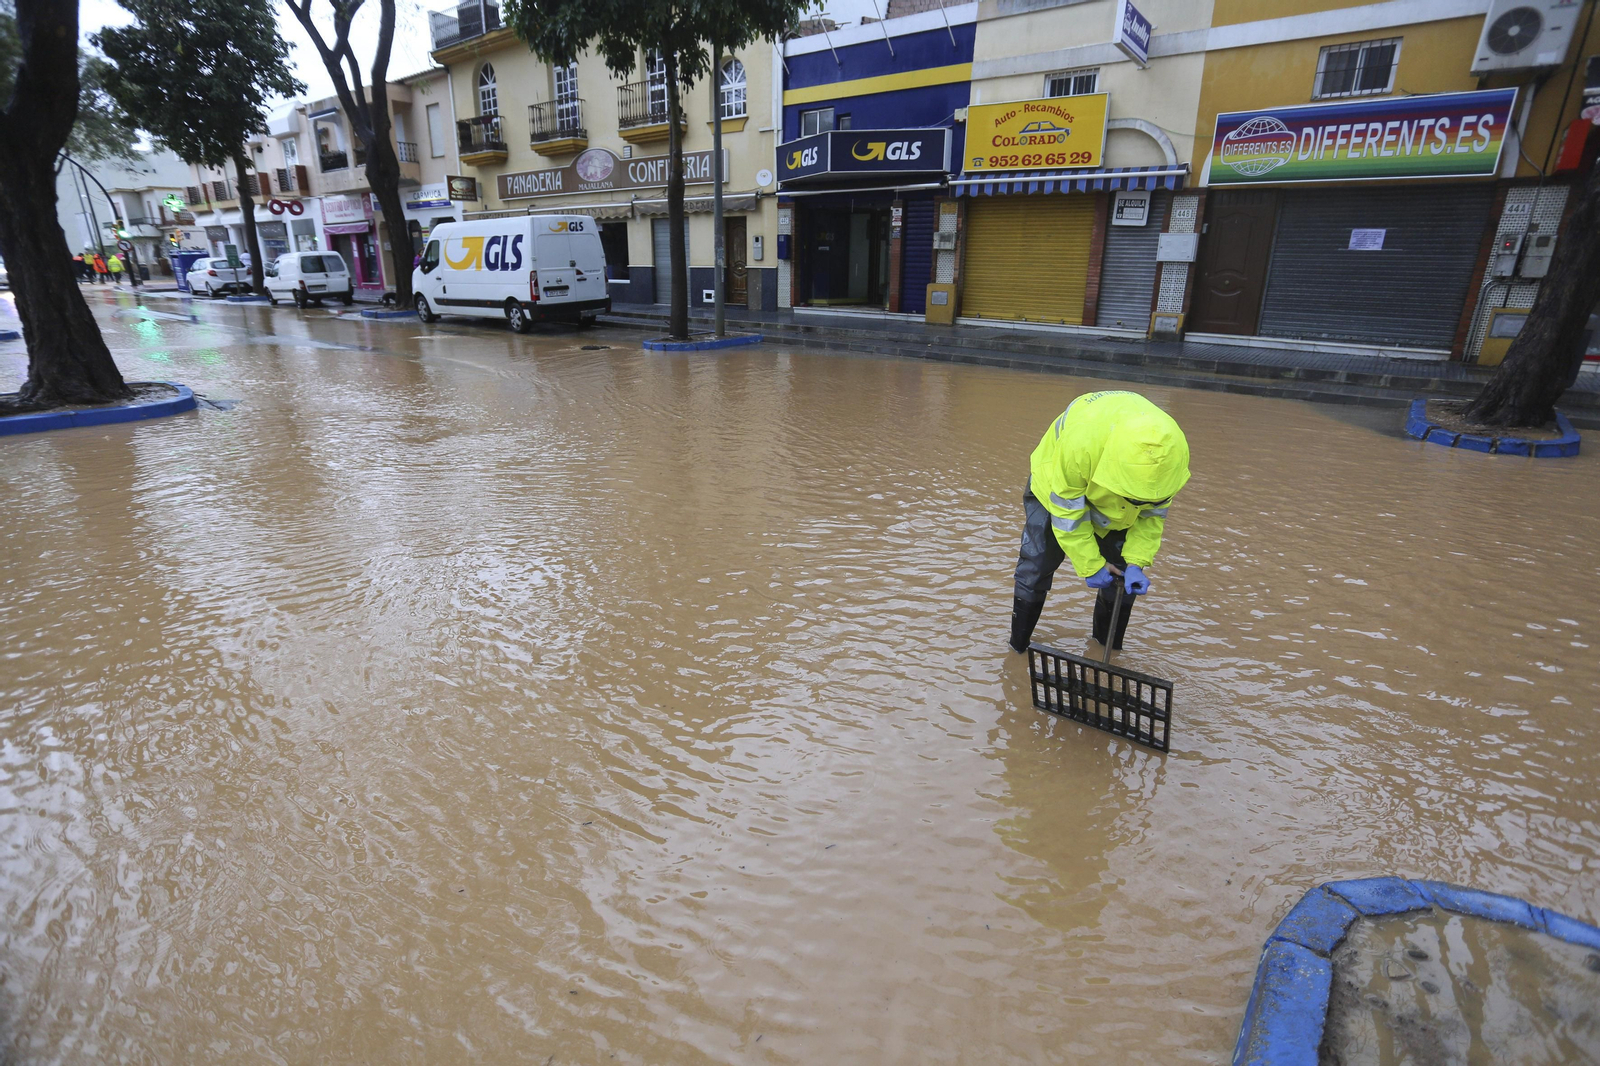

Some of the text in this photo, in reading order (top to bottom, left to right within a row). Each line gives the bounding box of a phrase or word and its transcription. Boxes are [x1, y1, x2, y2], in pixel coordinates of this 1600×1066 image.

[994, 110, 1016, 128] Auto
[1023, 103, 1075, 124] Recambios
[1297, 113, 1494, 161] DIFFERENTS.ES
[801, 146, 818, 167] GLS
[886, 141, 922, 161] GLS
[1224, 139, 1292, 157] DIFFERENTS.ES
[989, 151, 1092, 168] 952 62 65 29
[506, 171, 563, 195] PANADERIA
[578, 181, 613, 191] MAJALLANA
[412, 190, 442, 200] CARMUCA
[1118, 199, 1145, 207] SE ALQUILA
[568, 221, 584, 232] GLS
[484, 234, 524, 272] GLS
